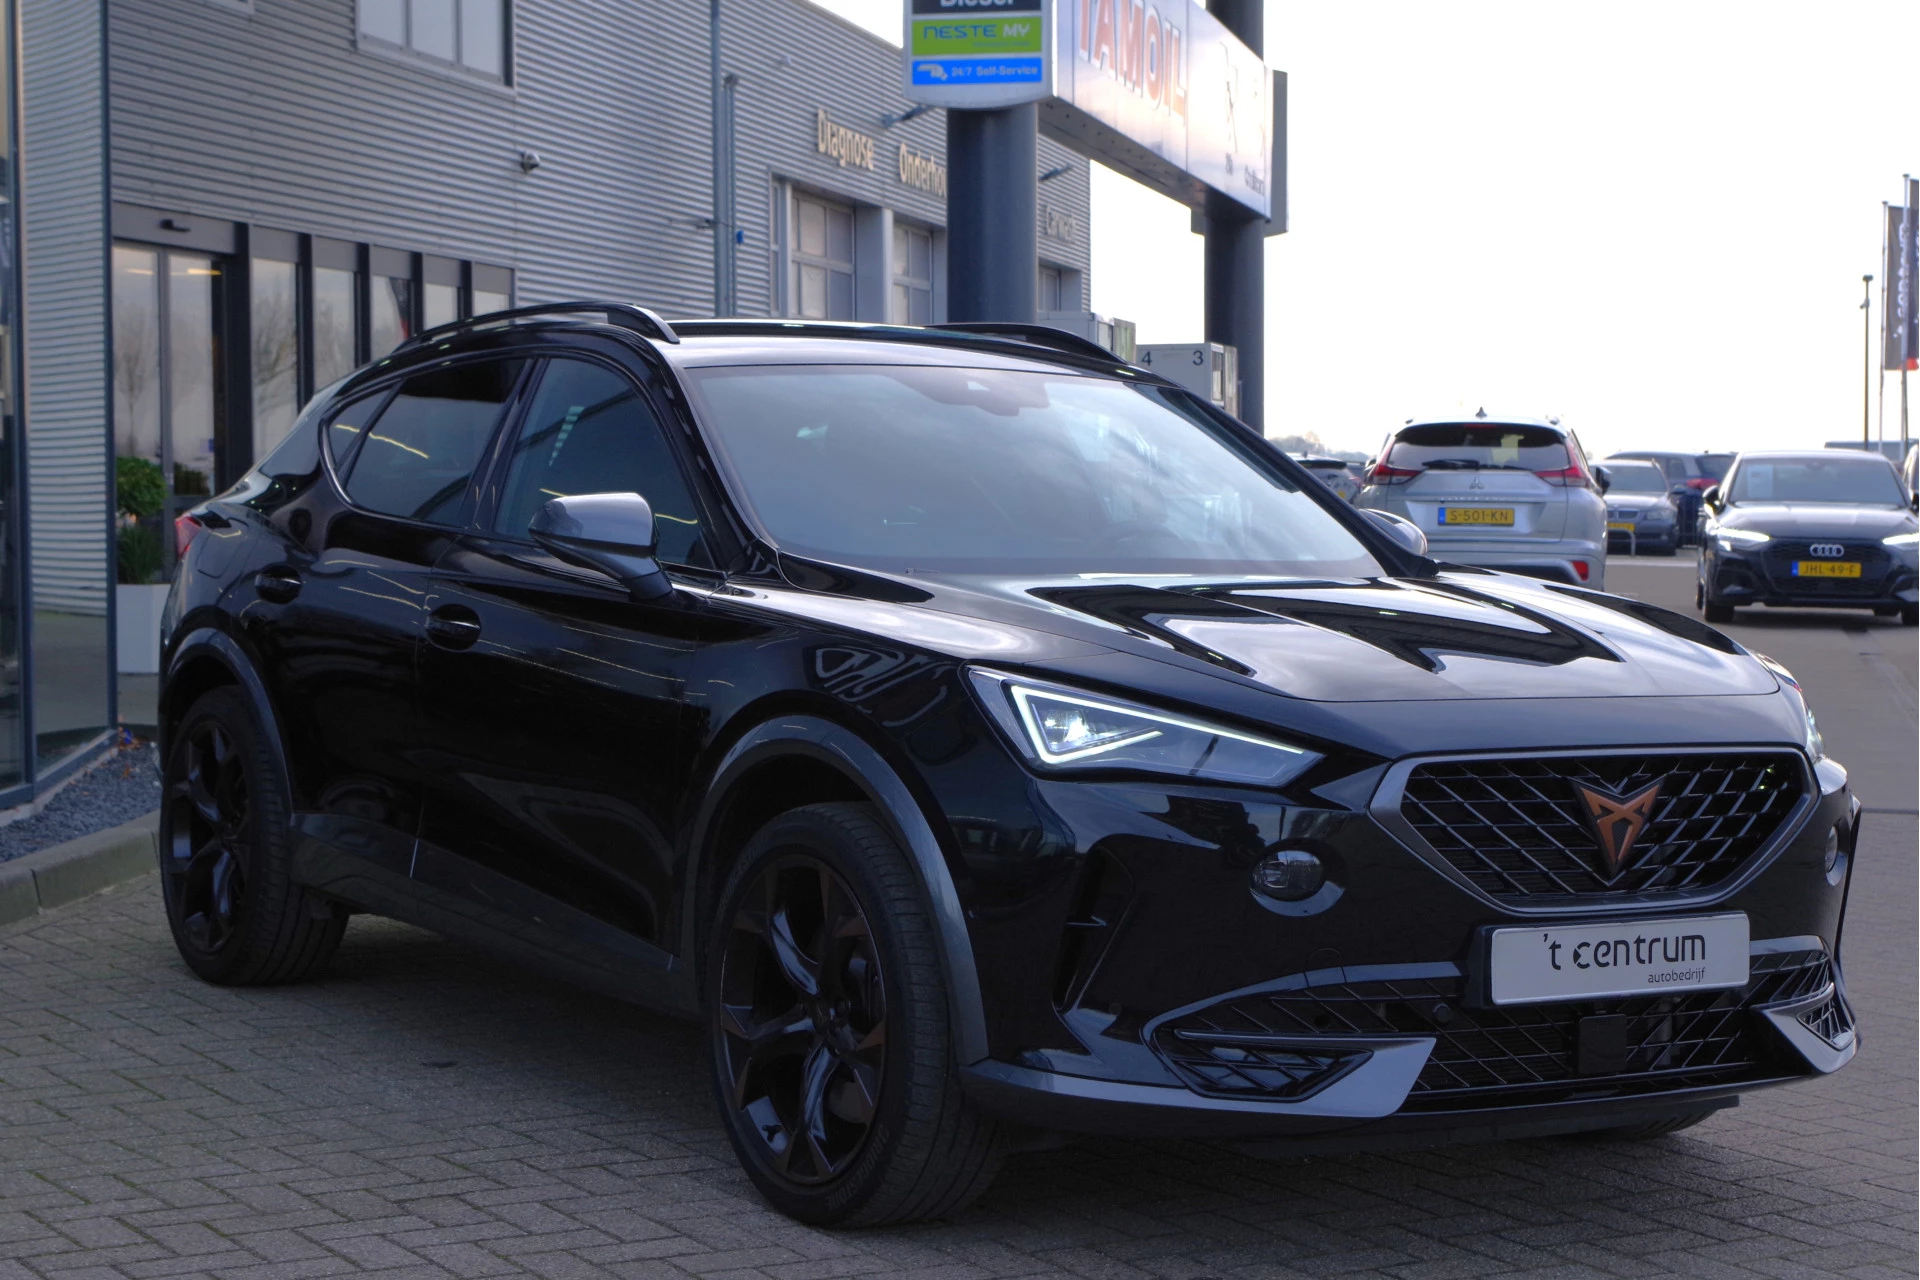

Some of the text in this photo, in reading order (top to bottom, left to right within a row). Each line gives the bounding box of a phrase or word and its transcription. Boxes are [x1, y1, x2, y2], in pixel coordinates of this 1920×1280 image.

[923, 23, 1032, 39] NESTE MY
[951, 65, 1038, 77] 24/7 Self-Service
[817, 108, 874, 171] Diagnose
[1141, 351, 1152, 366] 4
[1193, 350, 1204, 366] 3
[1450, 510, 1508, 521] S-501-KN
[1803, 564, 1855, 576] JHL-49-F
[1543, 933, 1705, 970] 't centrum
[1647, 967, 1706, 983] autobedrijf
